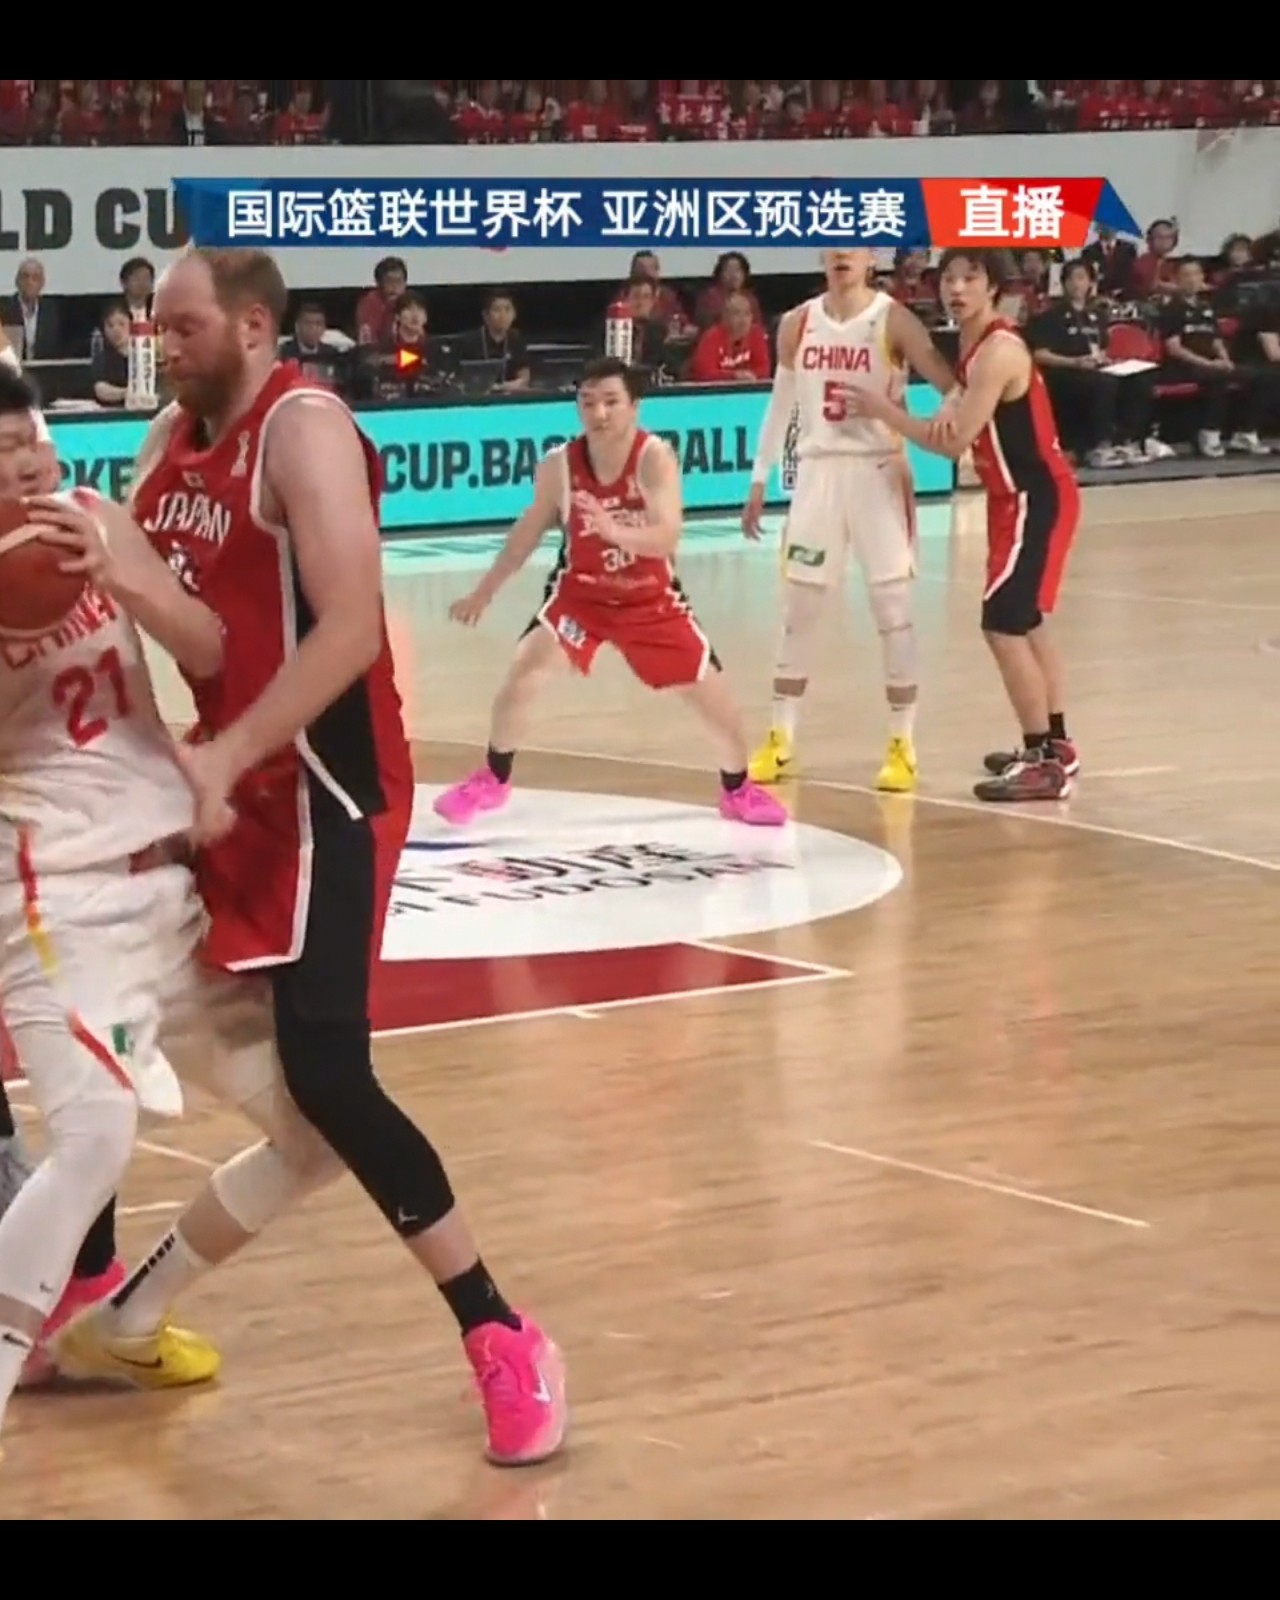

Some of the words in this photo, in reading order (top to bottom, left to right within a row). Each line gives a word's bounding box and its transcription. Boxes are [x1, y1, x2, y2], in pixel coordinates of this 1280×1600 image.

[95, 187, 191, 249] CU
[803, 345, 871, 373] CHINA
[823, 381, 847, 421] 5
[143, 490, 232, 549] JAPAN
[51, 645, 130, 747] 21
